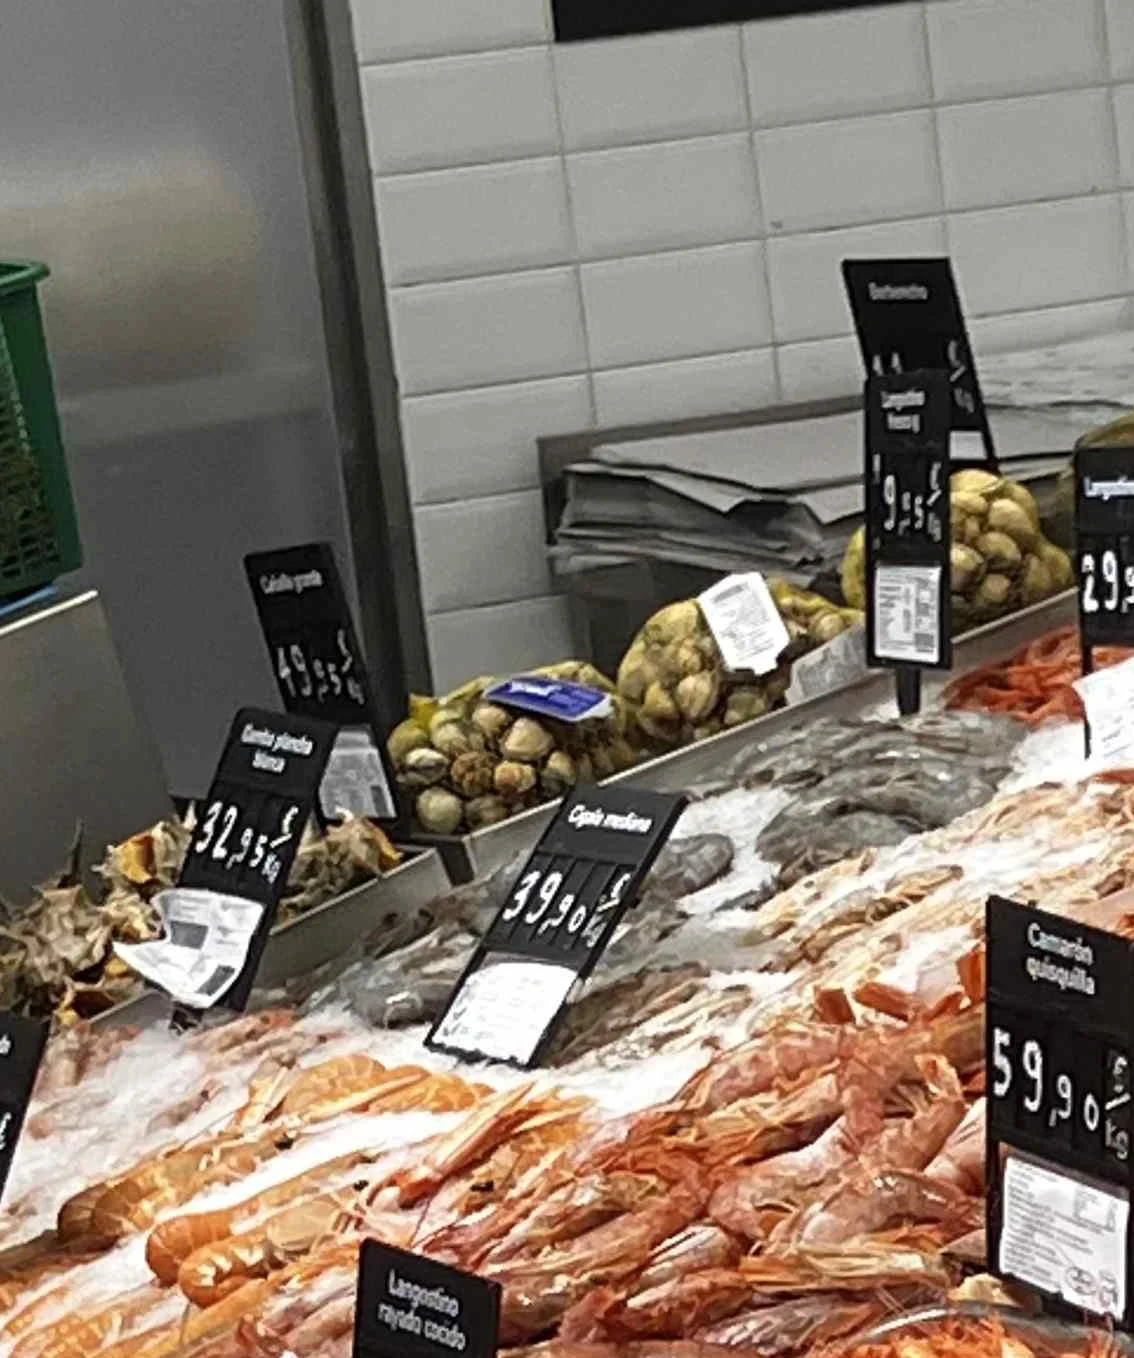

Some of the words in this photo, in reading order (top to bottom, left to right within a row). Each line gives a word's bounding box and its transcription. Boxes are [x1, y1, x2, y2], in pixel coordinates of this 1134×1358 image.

[195, 801, 269, 871] 32,95
[502, 870, 588, 936] 39,90
[993, 1027, 1101, 1132] 59,90
